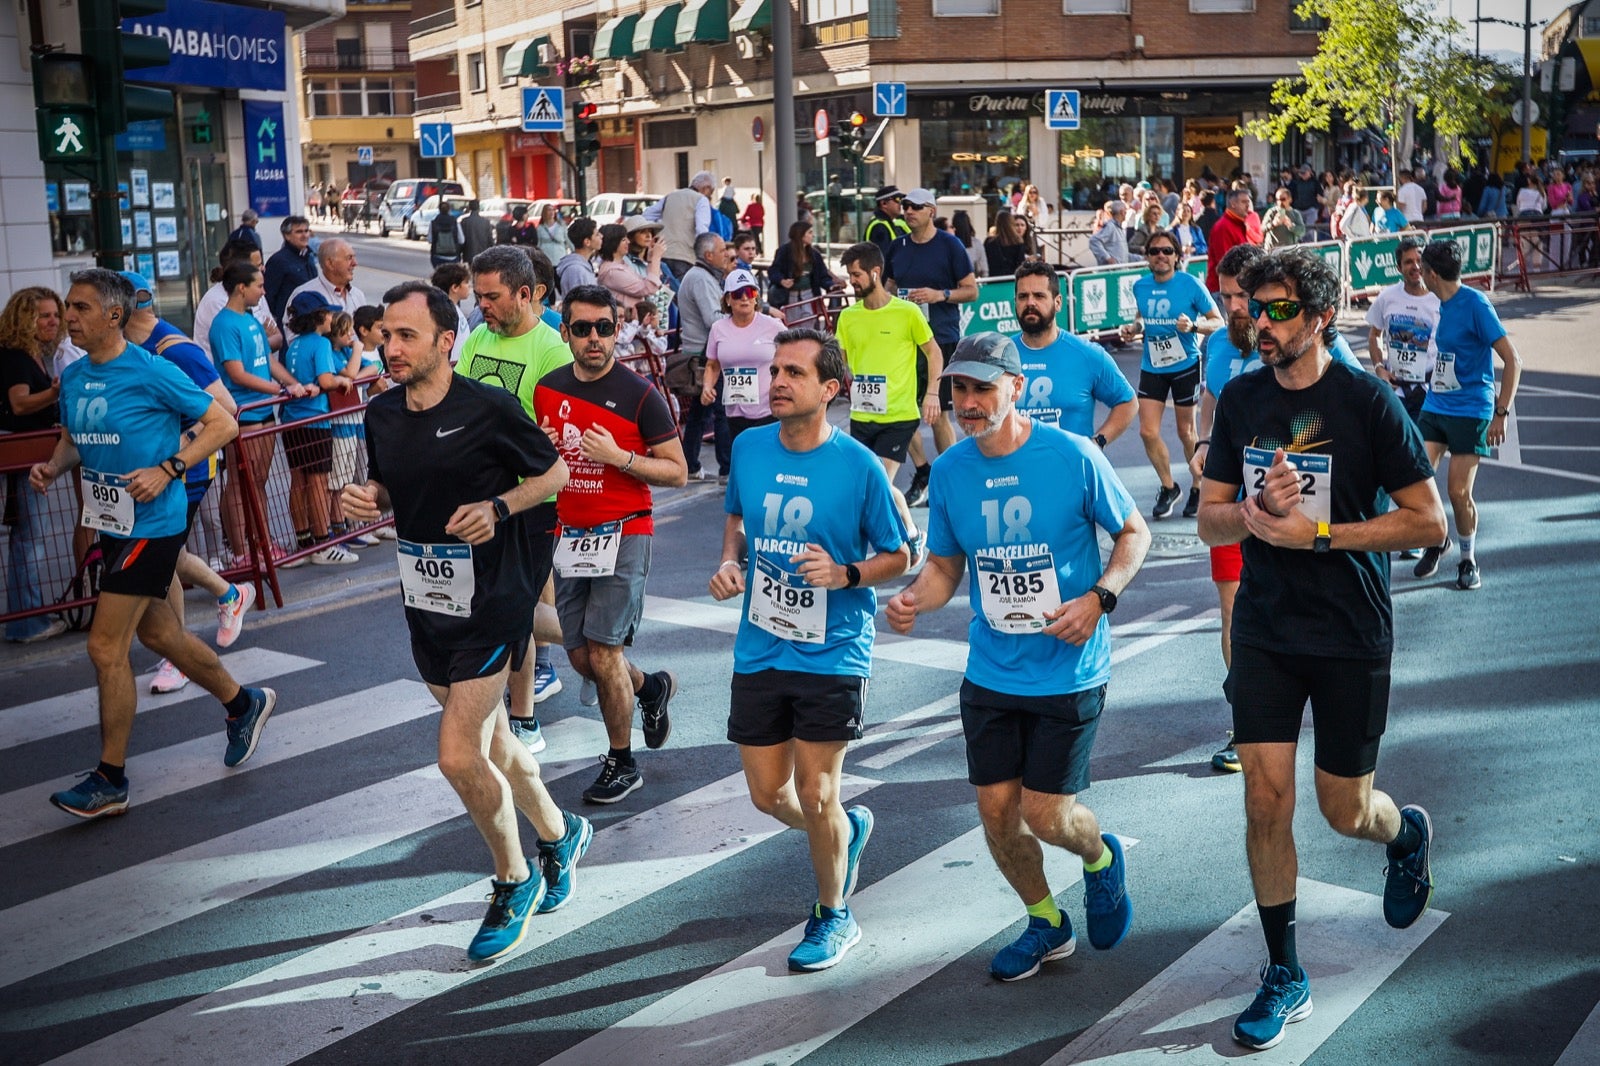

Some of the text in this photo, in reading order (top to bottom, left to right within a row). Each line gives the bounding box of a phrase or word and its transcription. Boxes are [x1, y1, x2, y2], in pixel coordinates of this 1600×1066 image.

[969, 95, 1028, 112] Puerta
[254, 168, 286, 181] ALDABA
[979, 300, 1014, 320] CAJA
[1146, 298, 1171, 318] 18
[1396, 349, 1418, 363] 782
[727, 375, 753, 387] 1934
[856, 383, 881, 395] 1935
[75, 396, 109, 432] 18
[92, 483, 120, 504] 890
[763, 492, 814, 541] 18
[981, 495, 1033, 545] 18
[571, 535, 613, 552] 1617
[754, 538, 808, 556] MARCELI
[414, 558, 455, 580] 406
[421, 576, 452, 586] FERNANDO
[988, 572, 1045, 596] 2185
[762, 576, 815, 608] 2198
[770, 598, 801, 615] FERNANDO
